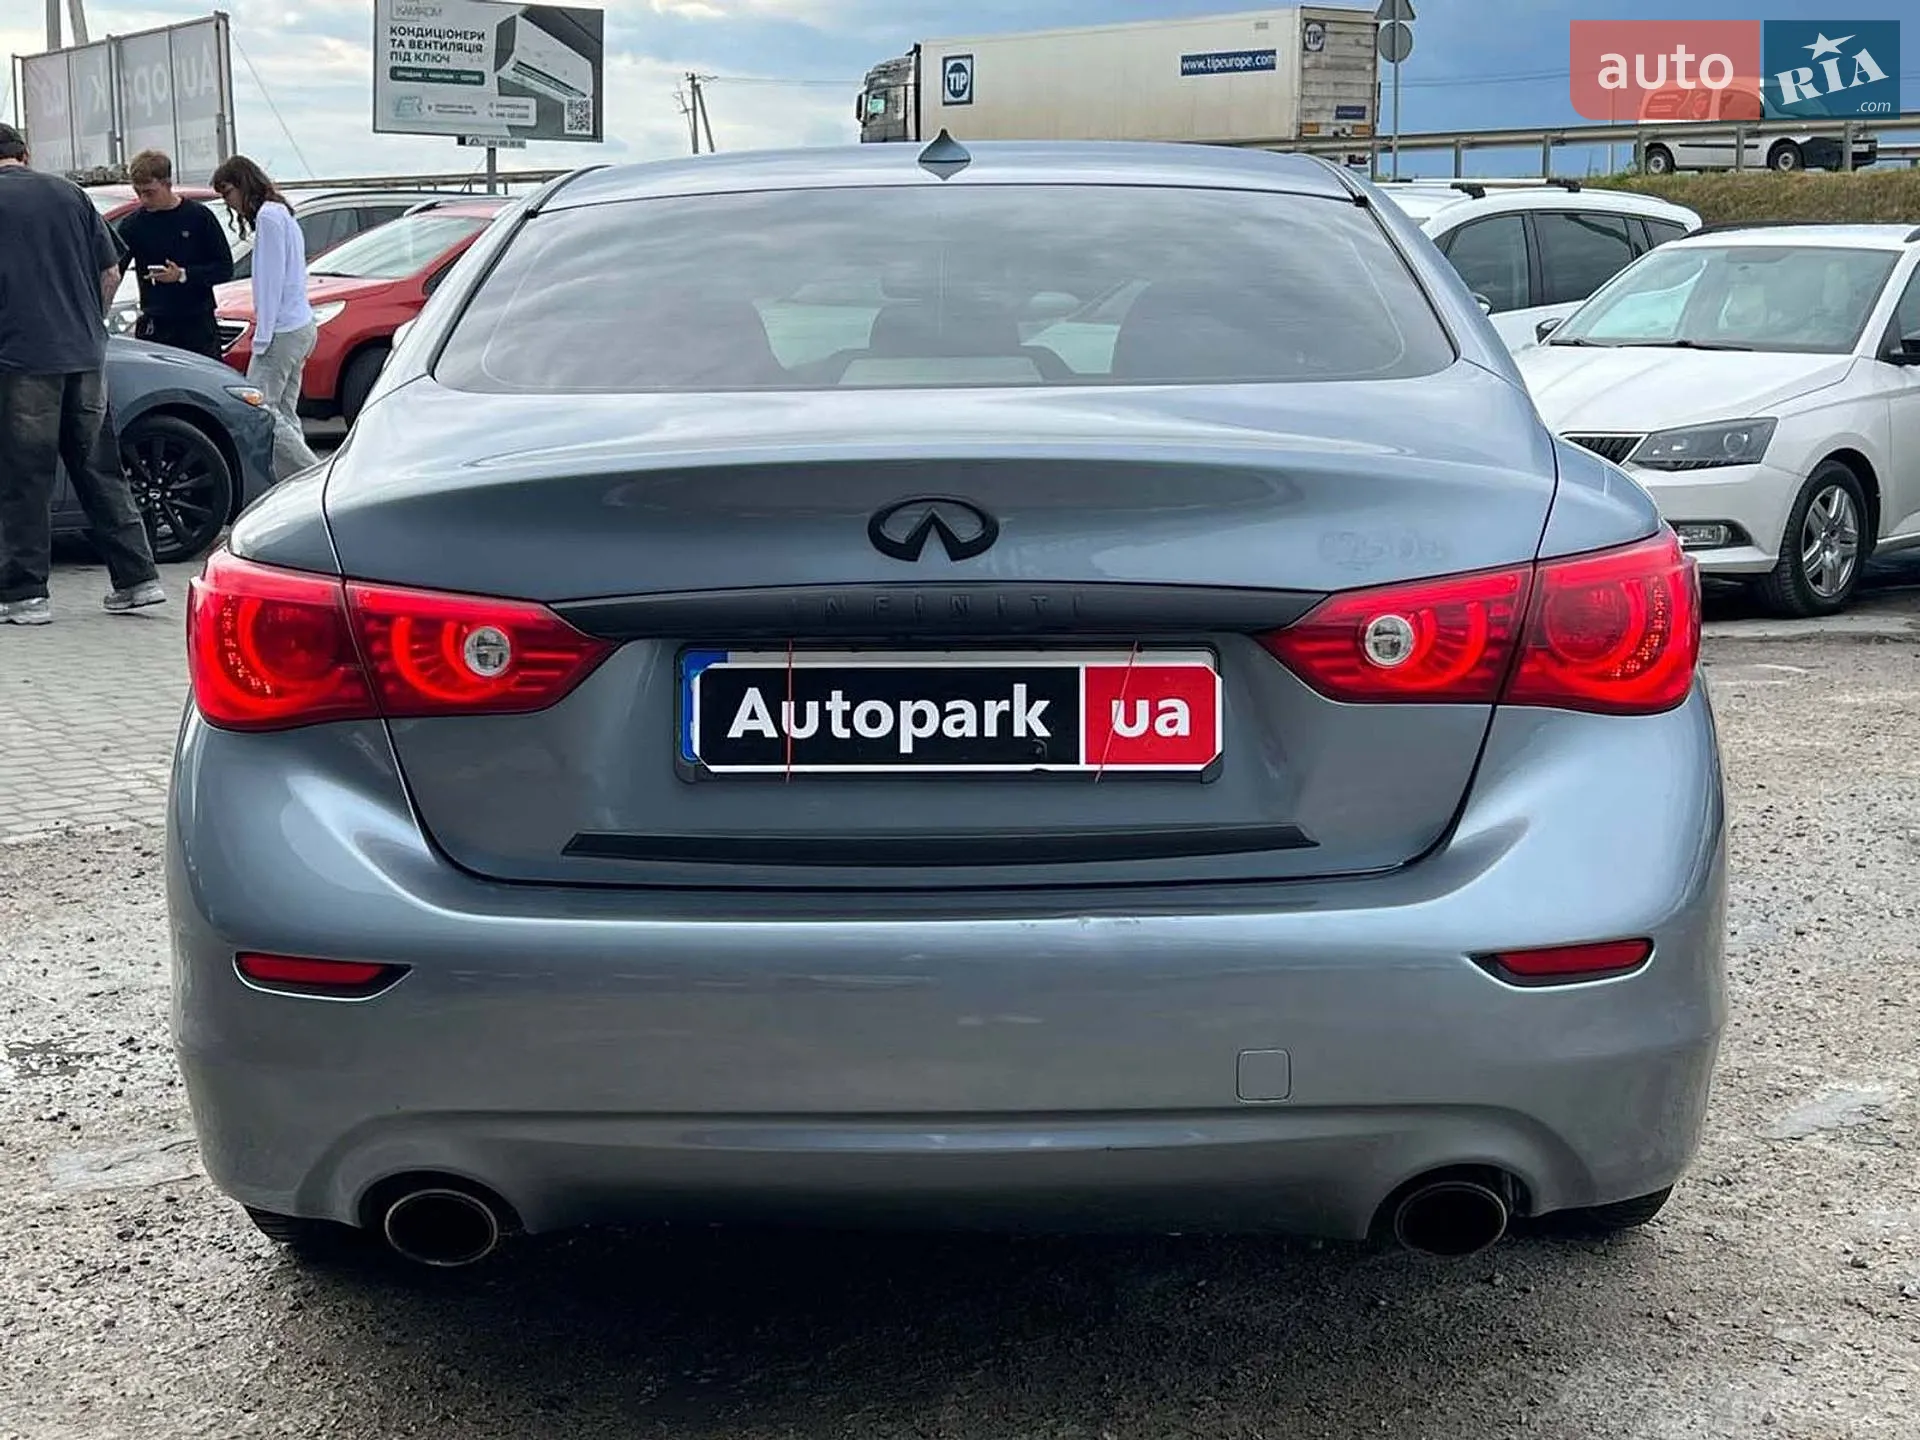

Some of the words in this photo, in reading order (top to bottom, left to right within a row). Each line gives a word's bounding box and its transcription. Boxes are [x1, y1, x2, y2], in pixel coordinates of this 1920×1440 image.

[390, 26, 485, 40] КОНДИЦІОНЕРИ
[390, 38, 405, 49] ТА
[409, 39, 482, 54] ВЕНТИЛЯЦІЯ
[390, 51, 411, 62] ПІД
[414, 52, 450, 63] КЛЮЧ
[1183, 55, 1277, 71] www.tipeurope.com
[948, 72, 967, 90] TIP
[727, 685, 1050, 753] Autopark
[1112, 698, 1190, 737] ua
